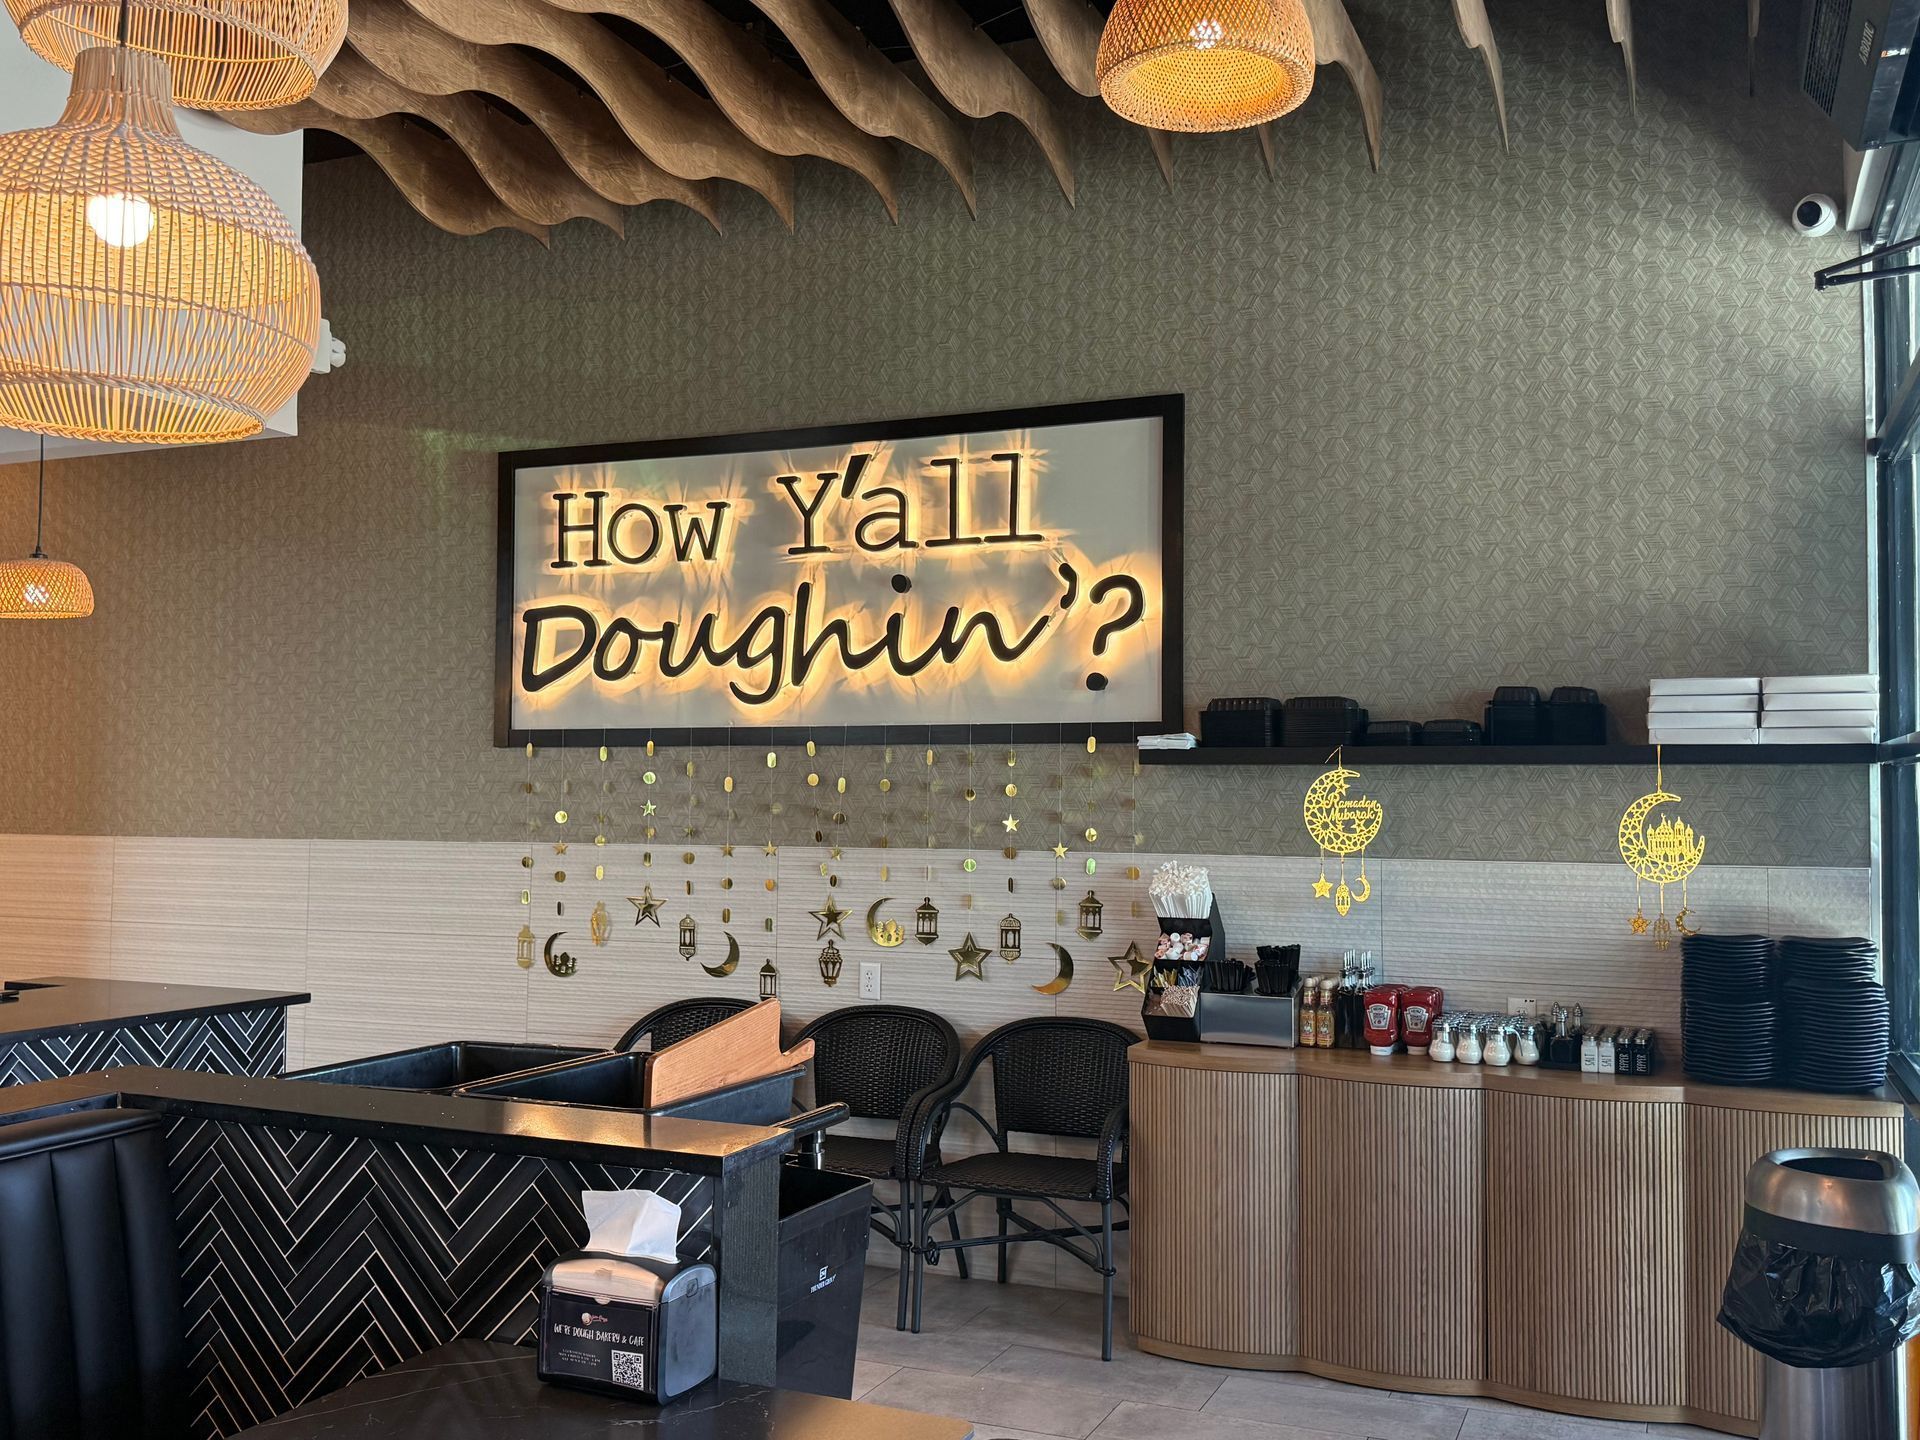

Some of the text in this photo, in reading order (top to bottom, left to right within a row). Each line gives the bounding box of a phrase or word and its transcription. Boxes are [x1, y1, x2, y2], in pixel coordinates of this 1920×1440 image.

[551, 452, 1045, 569] How Y'all
[521, 562, 1145, 704] Doughin'?
[1325, 792, 1381, 811] Ramadan
[1329, 807, 1376, 821] Mubarak
[1619, 1053, 1629, 1071] PEPPER
[1636, 1054, 1647, 1072] PEPPER
[554, 1323, 571, 1336] WE'RE
[573, 1327, 594, 1340] DOUGH
[596, 1330, 620, 1343] BAKERY
[621, 1335, 627, 1344] &
